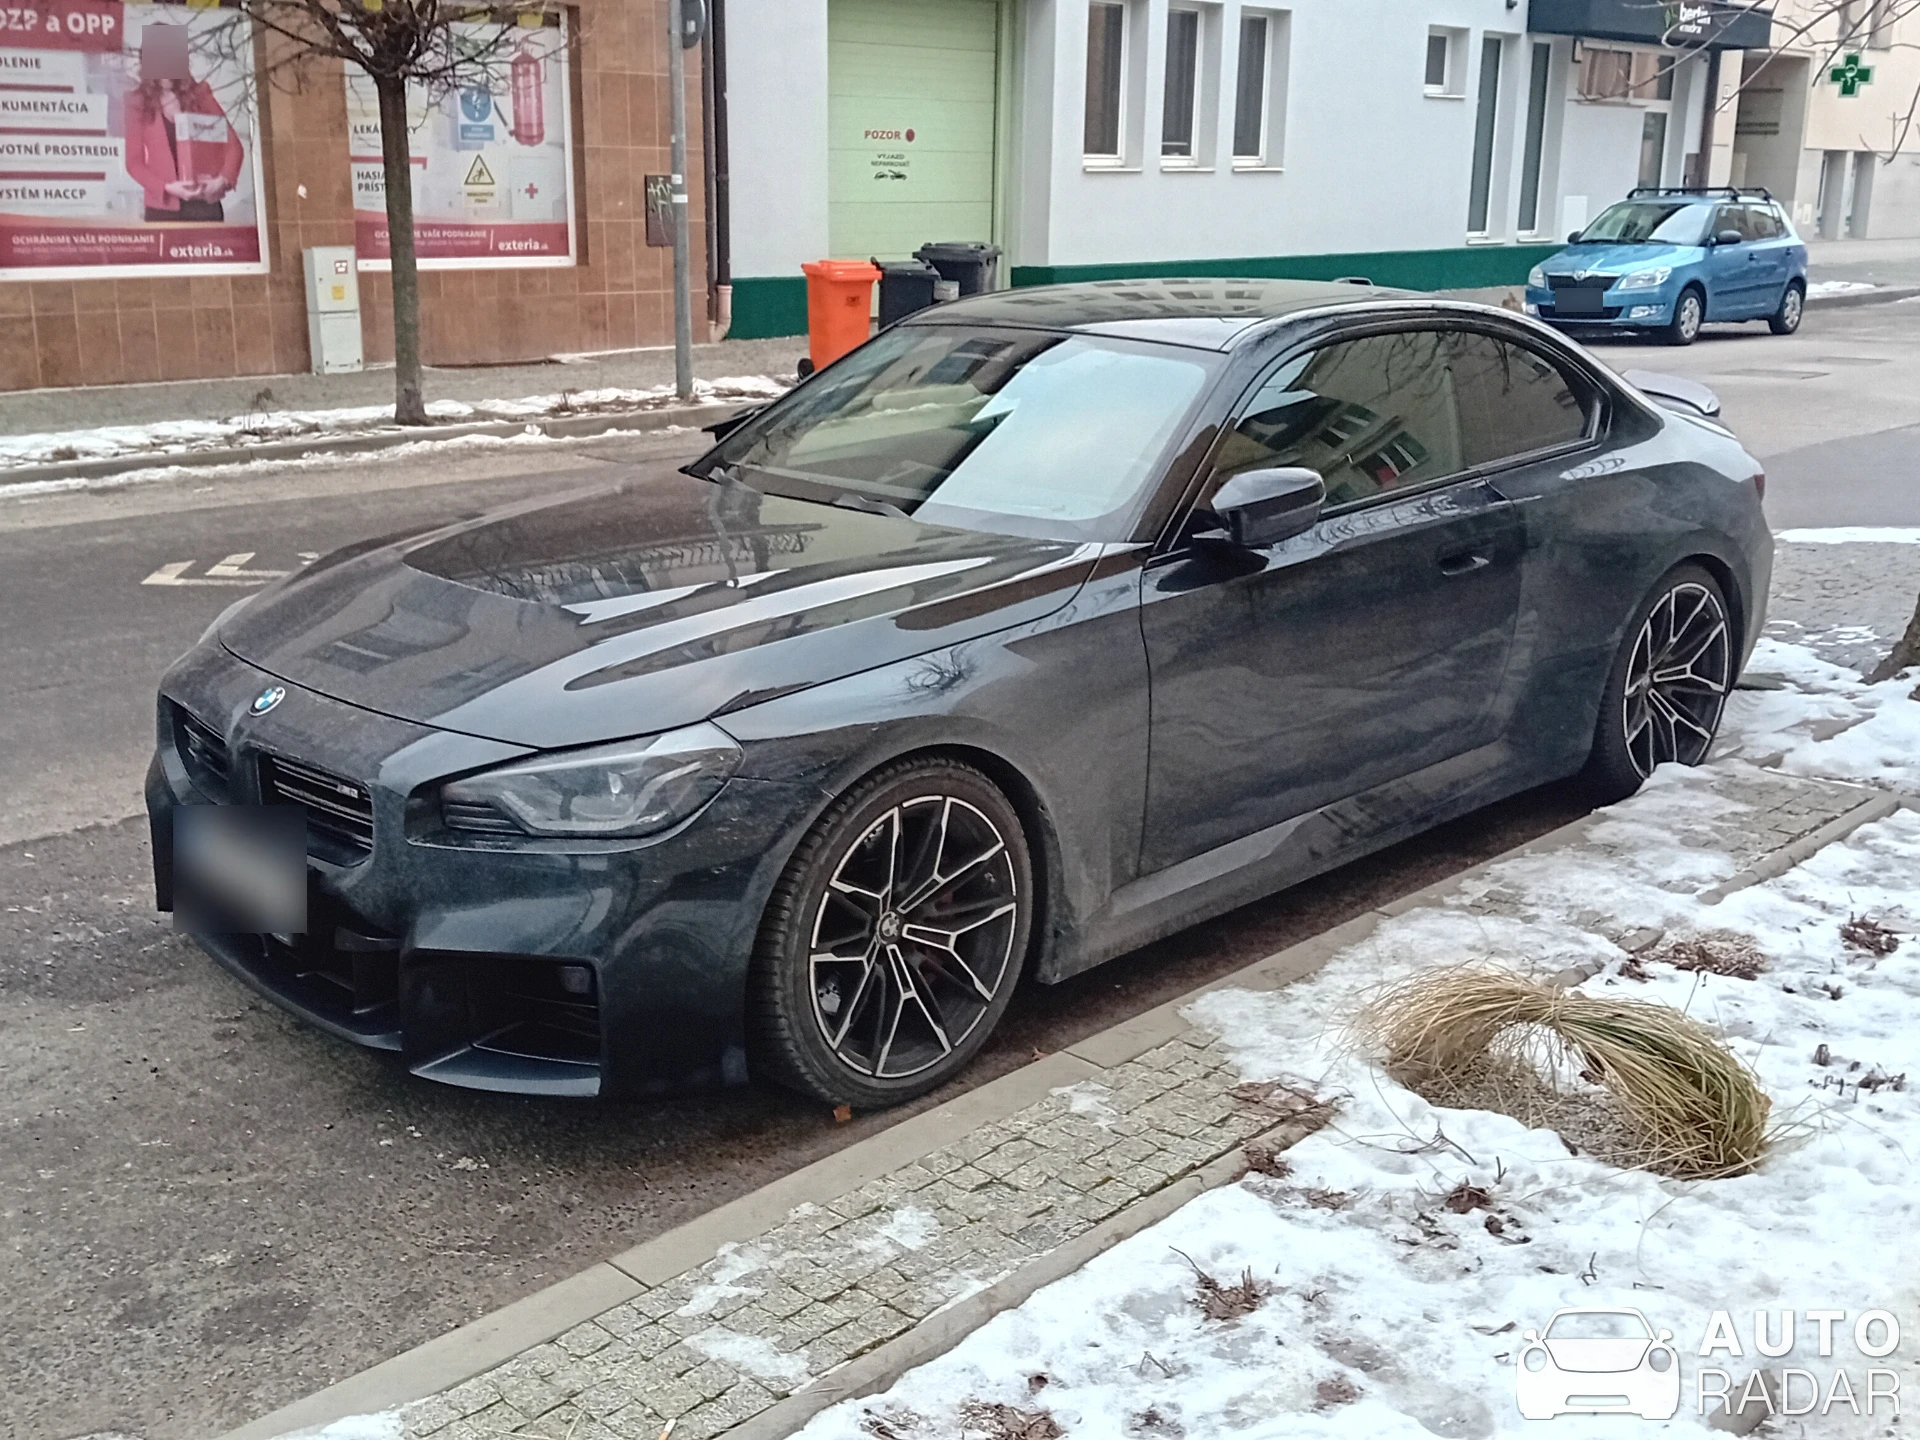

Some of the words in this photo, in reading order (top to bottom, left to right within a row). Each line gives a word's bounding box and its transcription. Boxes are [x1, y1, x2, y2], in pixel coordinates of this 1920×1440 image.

[46, 15, 60, 32] a
[67, 12, 115, 35] OPP
[0, 57, 41, 69] LENIE
[0, 100, 88, 113] KUMENTÁCIA
[864, 130, 901, 139] POZOR
[45, 145, 119, 157] PROSTREDIE
[358, 182, 386, 192] PRÍST
[44, 189, 87, 200] HACCP
